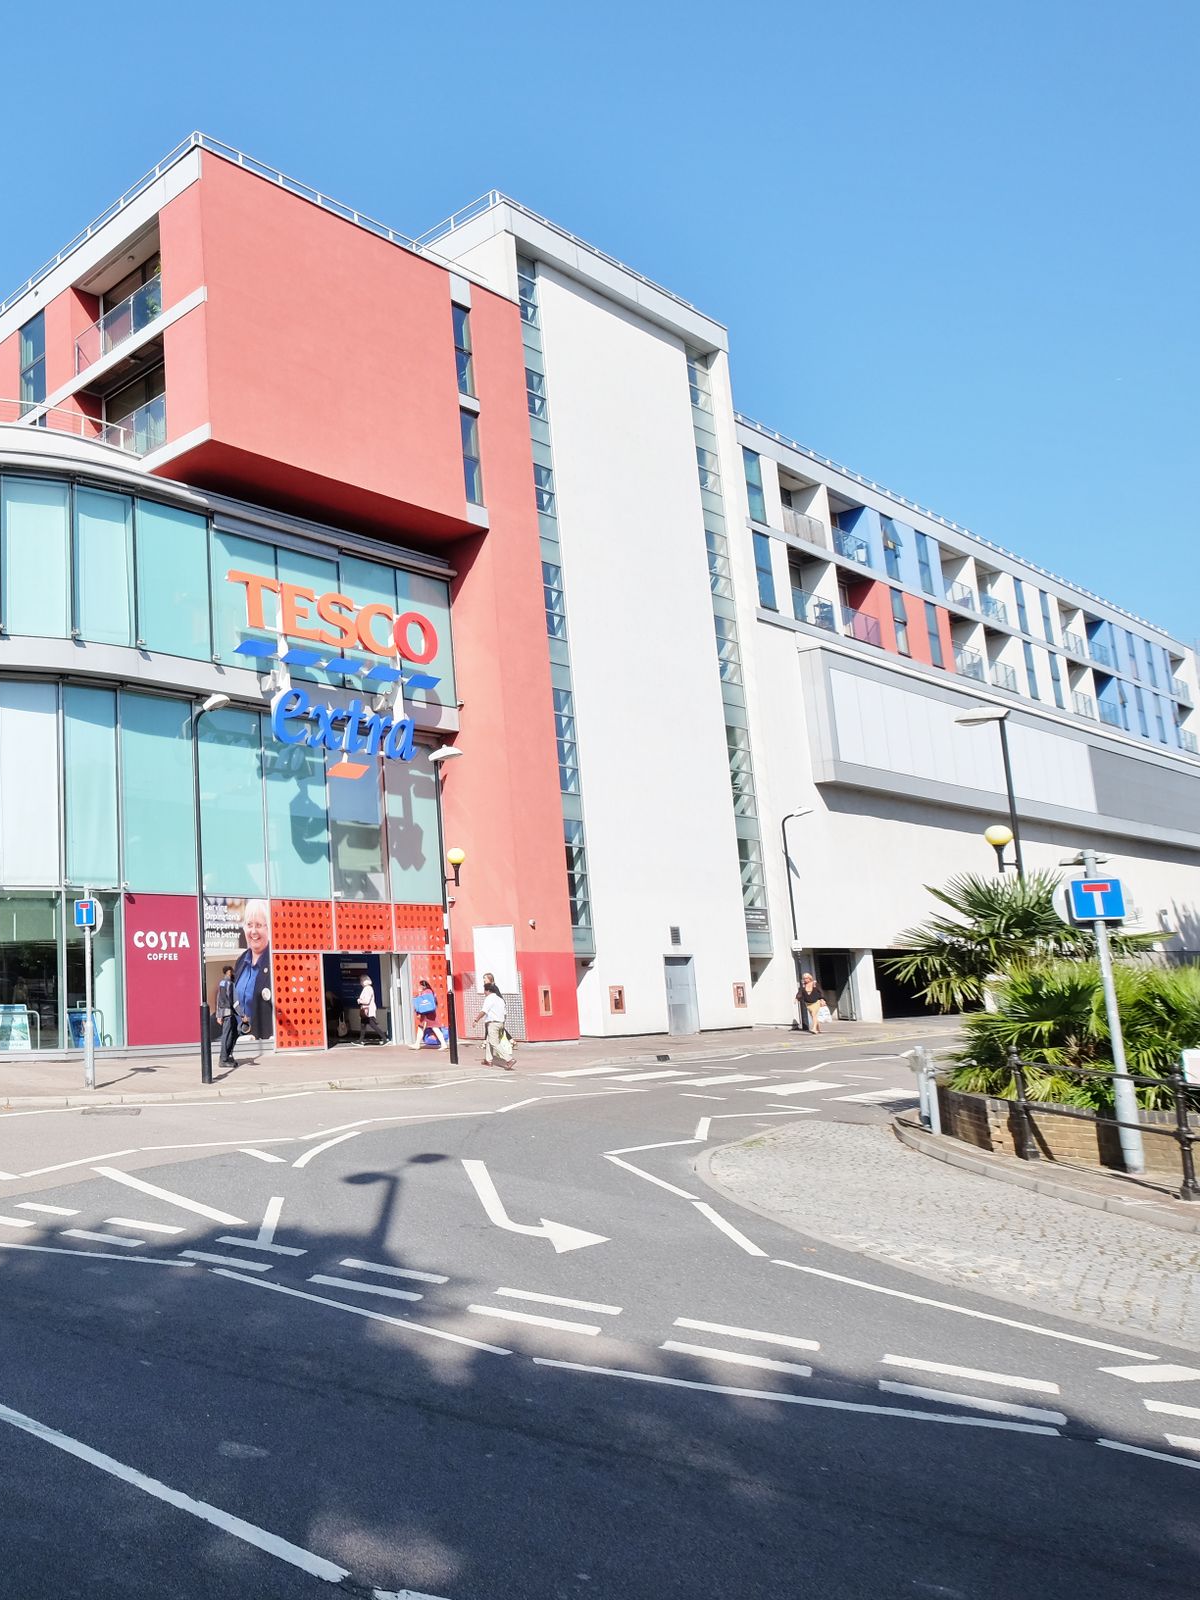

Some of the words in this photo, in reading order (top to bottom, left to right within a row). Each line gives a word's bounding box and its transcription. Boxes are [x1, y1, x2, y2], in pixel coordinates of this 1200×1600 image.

[226, 569, 438, 664] TESCO
[271, 688, 417, 761] extra
[204, 903, 228, 914] Serving
[205, 912, 241, 922] Orpington's
[204, 921, 233, 931] shoppers
[205, 930, 221, 938] little
[221, 930, 241, 938] better
[133, 930, 191, 951] COSTA
[205, 940, 223, 949] every
[224, 939, 236, 949] day
[147, 953, 179, 961] COFFEE
